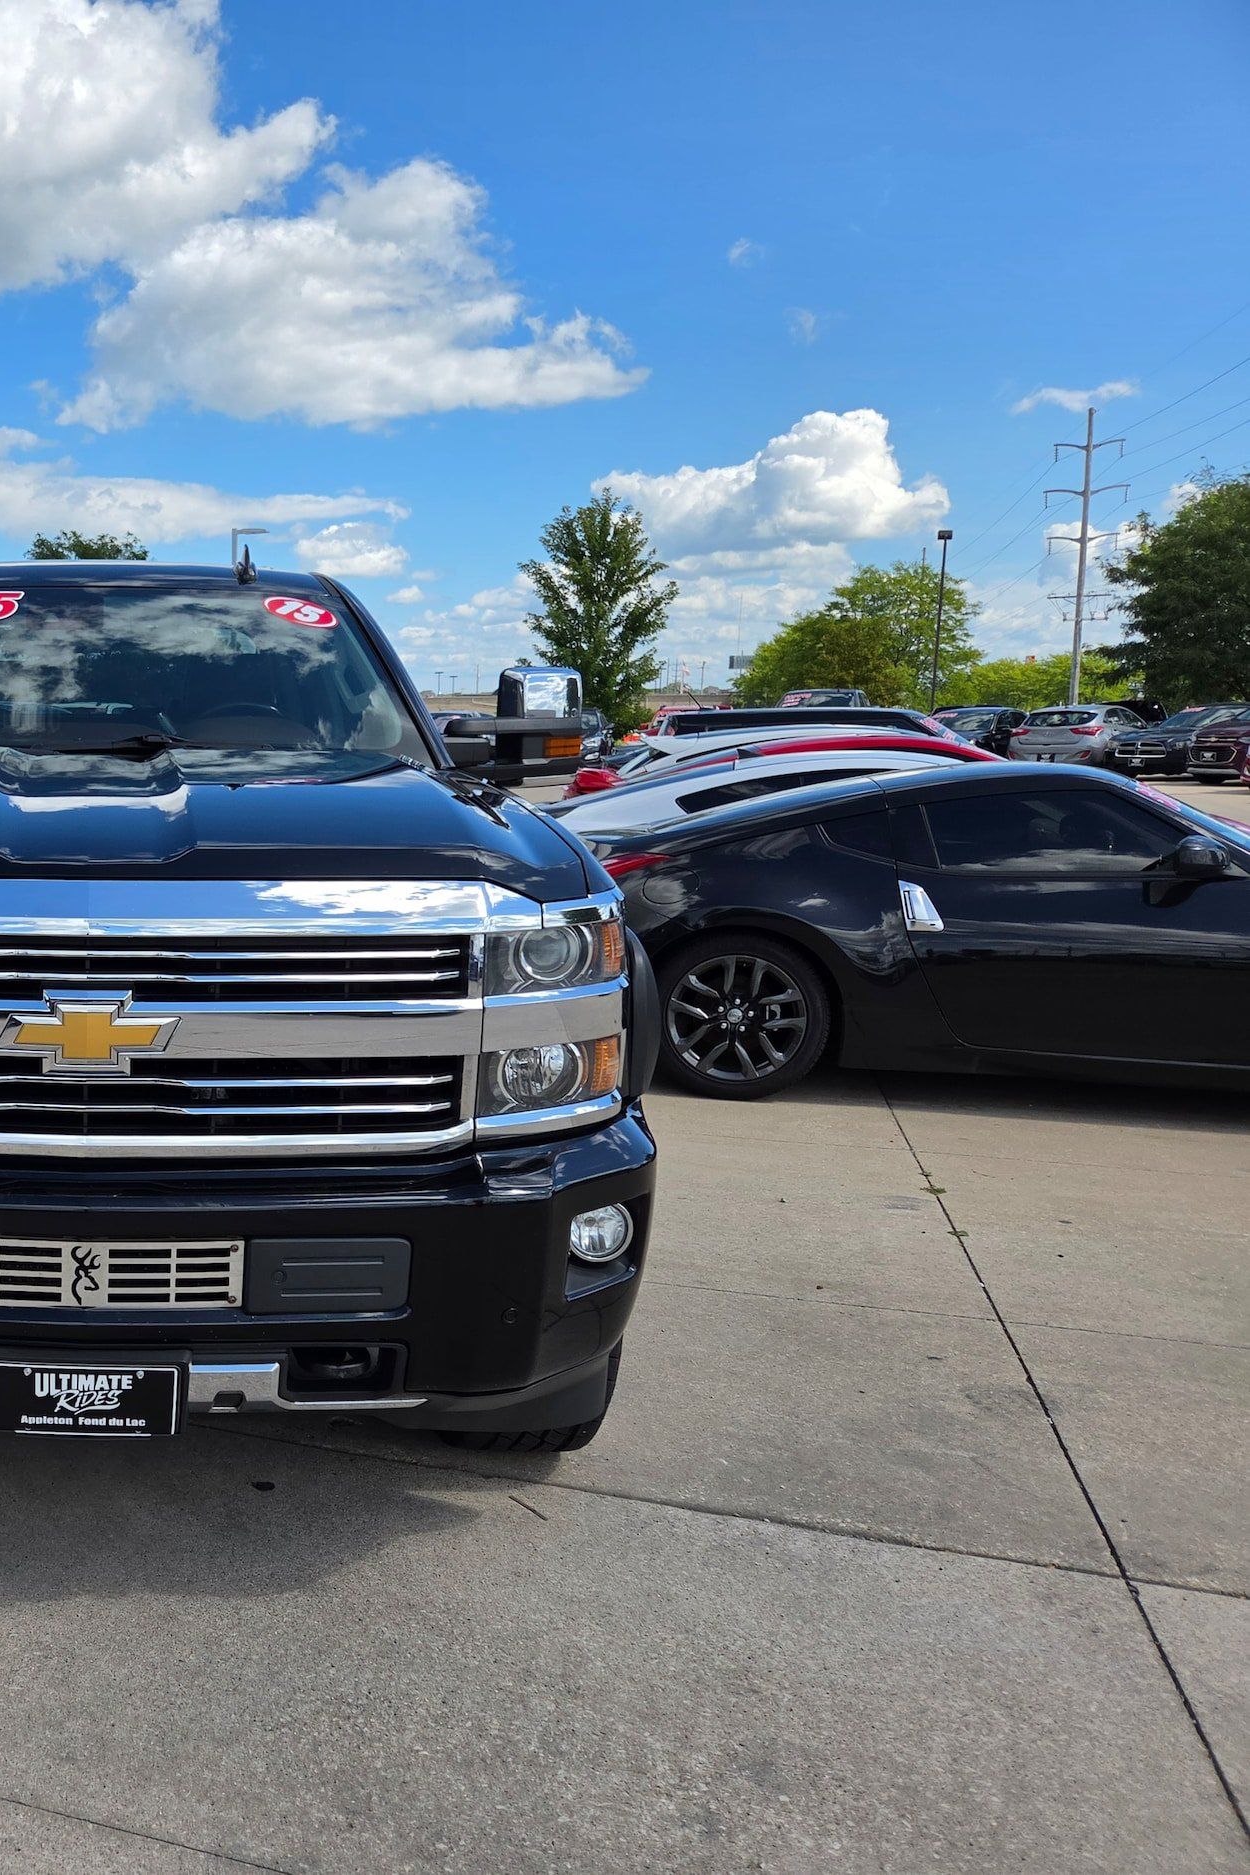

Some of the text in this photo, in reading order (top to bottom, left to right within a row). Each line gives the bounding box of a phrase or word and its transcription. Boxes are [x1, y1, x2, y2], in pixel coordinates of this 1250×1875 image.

[275, 601, 326, 622] 15
[34, 1372, 133, 1397] ULTIMATE
[20, 1415, 146, 1427] Appleton Fond du Lac
